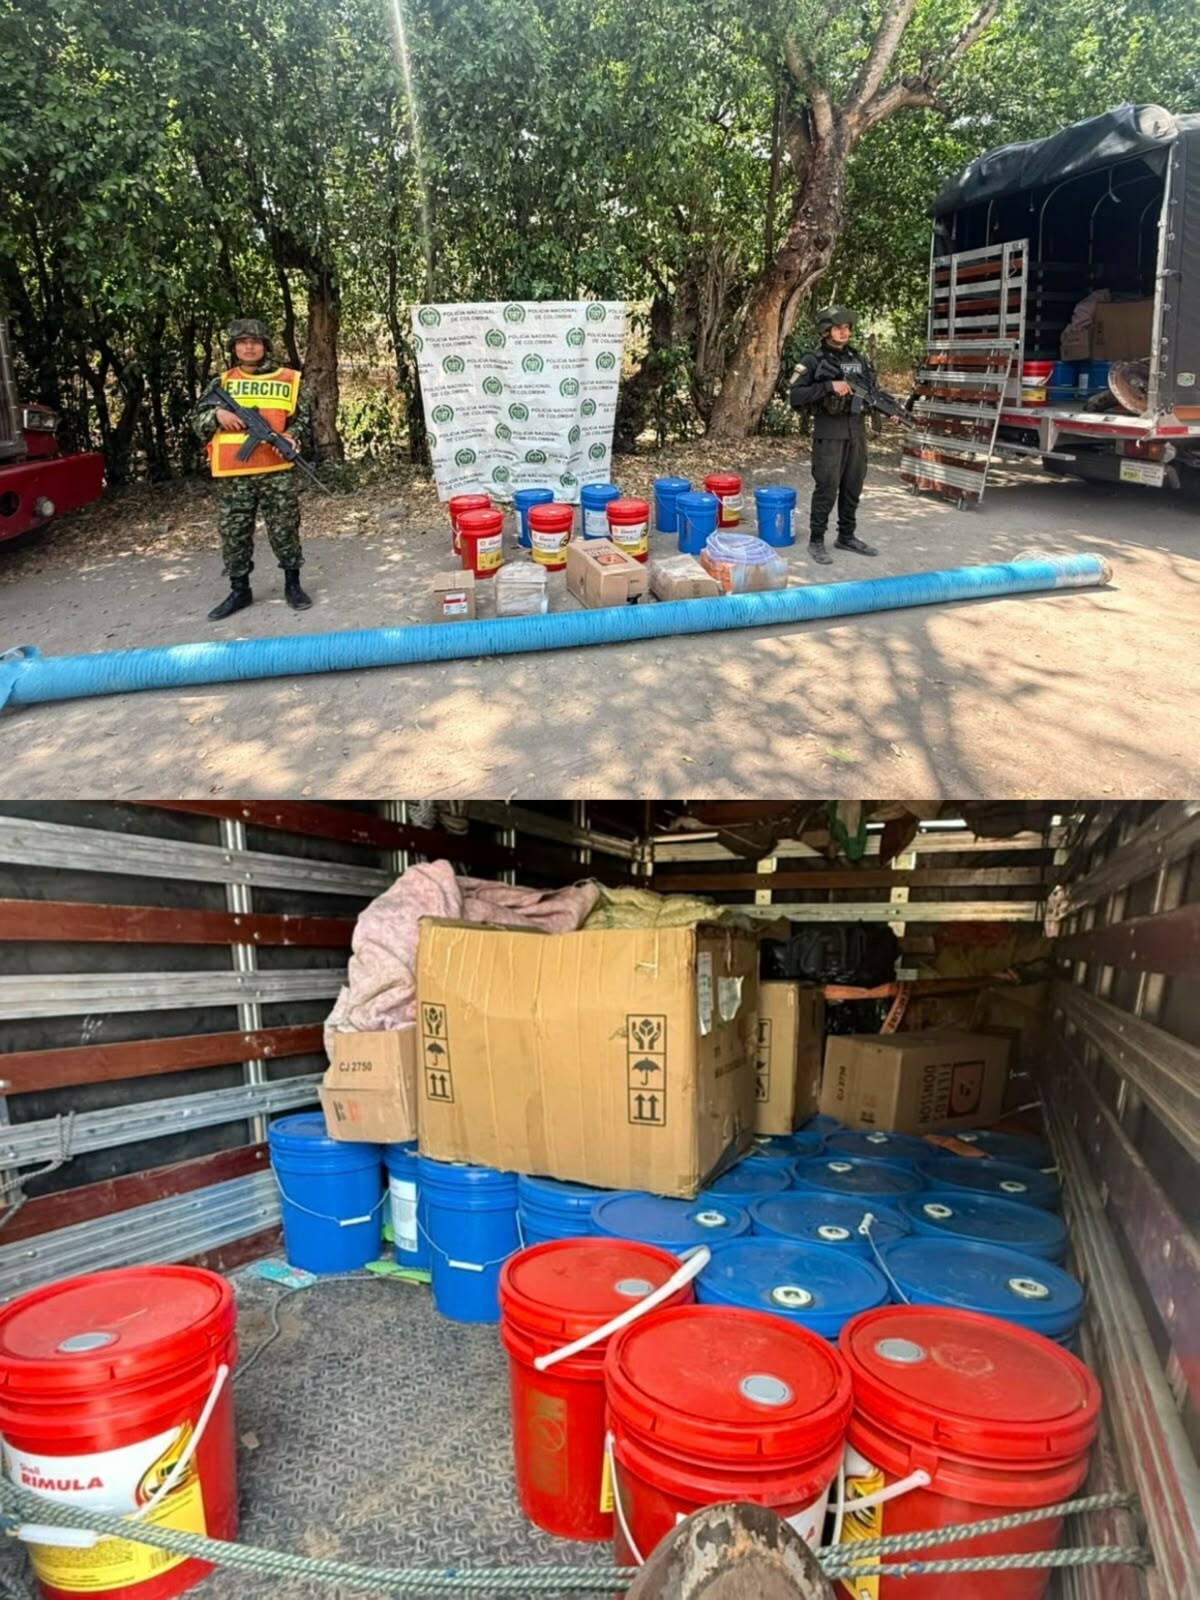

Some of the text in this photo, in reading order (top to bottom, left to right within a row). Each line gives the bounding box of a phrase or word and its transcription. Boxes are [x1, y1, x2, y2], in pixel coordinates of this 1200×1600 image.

[226, 381, 290, 398] EJERCITO
[339, 1060, 372, 1072] CJ 2750
[22, 1473, 104, 1492] RIMULA
